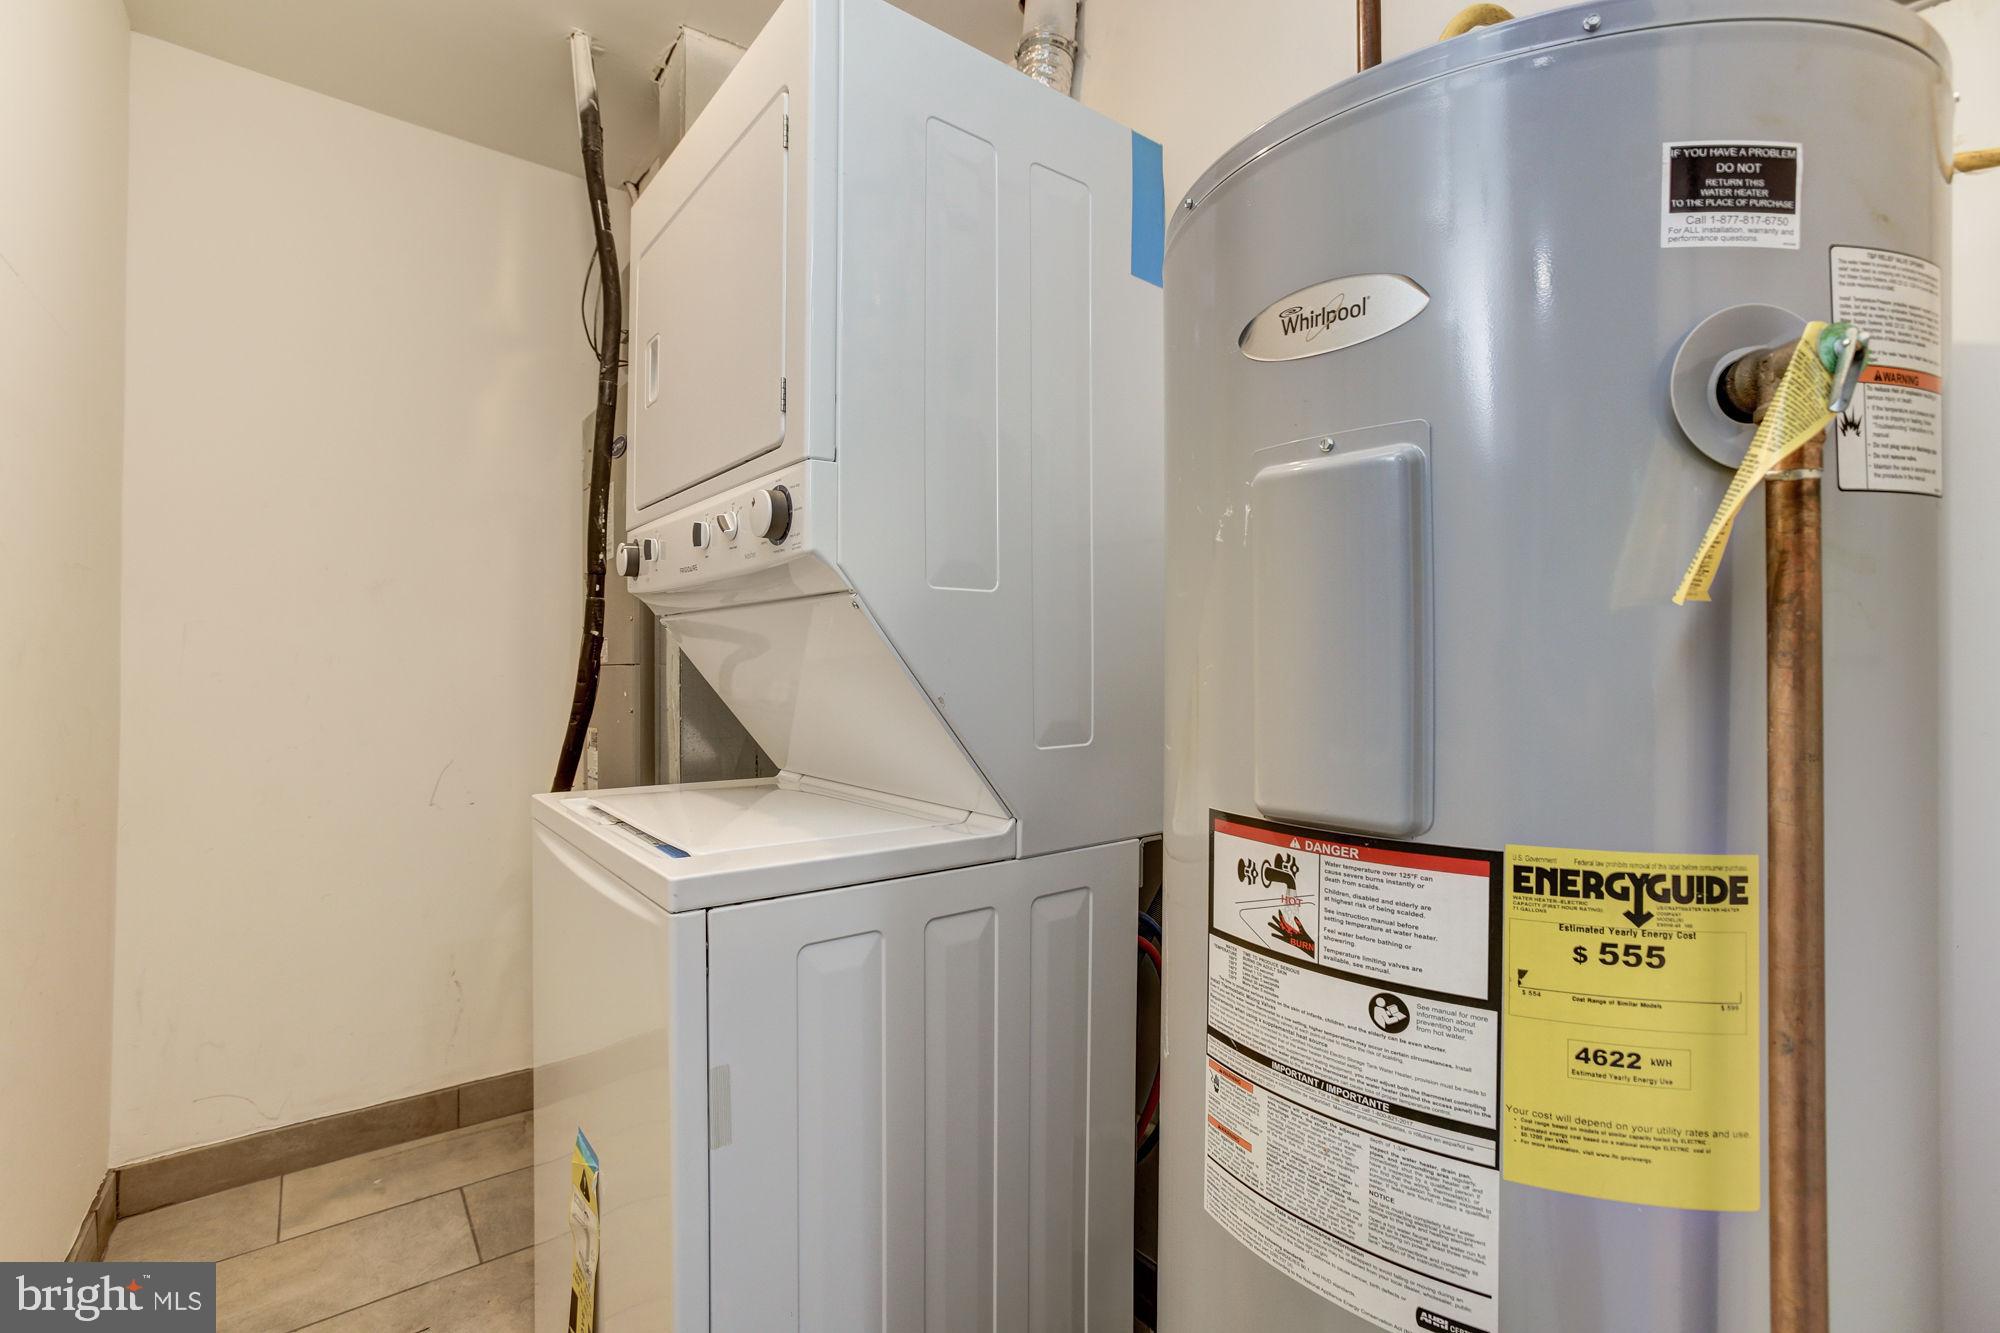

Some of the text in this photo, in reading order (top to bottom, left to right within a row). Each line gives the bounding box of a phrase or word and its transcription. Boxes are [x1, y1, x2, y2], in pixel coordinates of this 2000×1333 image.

[1671, 148, 1796, 159] IF YOU HAVE A PROBLEM
[1716, 163, 1762, 173] DO NOT
[1734, 189, 1769, 197] HEATER
[1706, 199, 1734, 207] PLACE
[1736, 199, 1748, 207] OF
[1750, 200, 1794, 209] PURCHASE
[1686, 216, 1789, 226] Call 1-877-817-6750
[1748, 228, 1778, 236] warranty
[1281, 297, 1366, 335] Whirlpool
[1883, 371, 1919, 386] WARNING
[1305, 840, 1359, 859] DANGER
[1525, 855, 1557, 863] Government
[1574, 858, 1593, 866] Federal
[1343, 864, 1380, 874] temperature
[1366, 875, 1383, 883] burns
[1386, 879, 1414, 889] instantly
[1513, 864, 1749, 907] ENERGYGUIDE
[1281, 895, 1303, 907] HOT
[1324, 888, 1351, 898] Children,
[1352, 893, 1379, 902] disabled
[1395, 900, 1418, 910] elderly
[1331, 897, 1353, 907] highest
[1376, 905, 1394, 915] being
[1397, 909, 1426, 919] scalded.
[1336, 910, 1369, 921] instruction
[1371, 917, 1395, 926] manual
[1397, 921, 1419, 930] before
[1324, 916, 1343, 925] setting
[1346, 921, 1383, 932] temperature
[1414, 933, 1438, 941] heater.
[1559, 923, 1696, 940] Estimated Yearly Energy Cost
[1291, 938, 1314, 951] BURN
[1356, 934, 1376, 943] before
[1378, 938, 1402, 949] bathing
[1324, 946, 1360, 960] Temperature
[1362, 956, 1386, 966] limiting
[1388, 962, 1410, 971] valves
[1573, 942, 1666, 969] $ 555
[1365, 965, 1391, 974] manual.
[1417, 1011, 1476, 1028] information about
[1431, 1006, 1457, 1016] manual
[1470, 1014, 1488, 1022] more
[1416, 1020, 1473, 1035] preventing burns
[1416, 1026, 1431, 1034] from
[1575, 1047, 1672, 1070] 4622 kWH
[1571, 1068, 1607, 1079] Estimated
[1610, 1074, 1630, 1083] Yearly
[1633, 1076, 1657, 1085] Energy
[1271, 1060, 1319, 1087] IMPORTANT
[1320, 1081, 1325, 1089] /
[1326, 1083, 1390, 1112] IMPORTANTE
[1506, 1104, 1528, 1116] Your
[1532, 1111, 1553, 1120] cost
[1556, 1115, 1572, 1123] will
[1575, 1116, 1612, 1129] depend
[1616, 1122, 1628, 1130] on
[1631, 1125, 1653, 1133] your
[1657, 1127, 1681, 1138] utility
[1685, 1129, 1709, 1138] rates
[1712, 1130, 1730, 1138] and
[1369, 1190, 1395, 1204] NOTICE
